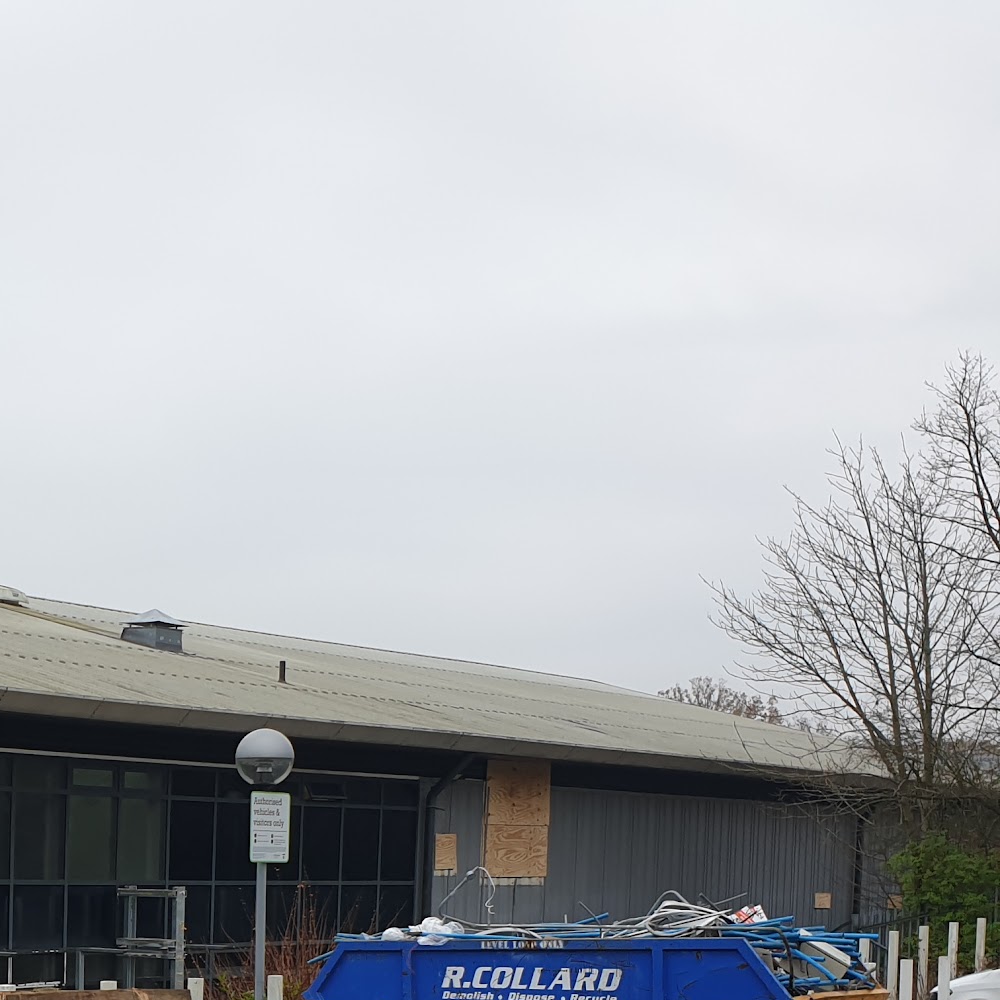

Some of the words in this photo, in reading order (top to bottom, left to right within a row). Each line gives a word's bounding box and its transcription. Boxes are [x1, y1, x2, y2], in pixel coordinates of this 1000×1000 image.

[254, 797, 282, 805] Authorised
[253, 808, 275, 816] vehicles
[273, 819, 284, 828] only
[480, 940, 510, 949] LEVEL
[539, 940, 564, 949] ONLY
[441, 966, 622, 991] R.COLLARD
[442, 990, 494, 1000] Demolish
